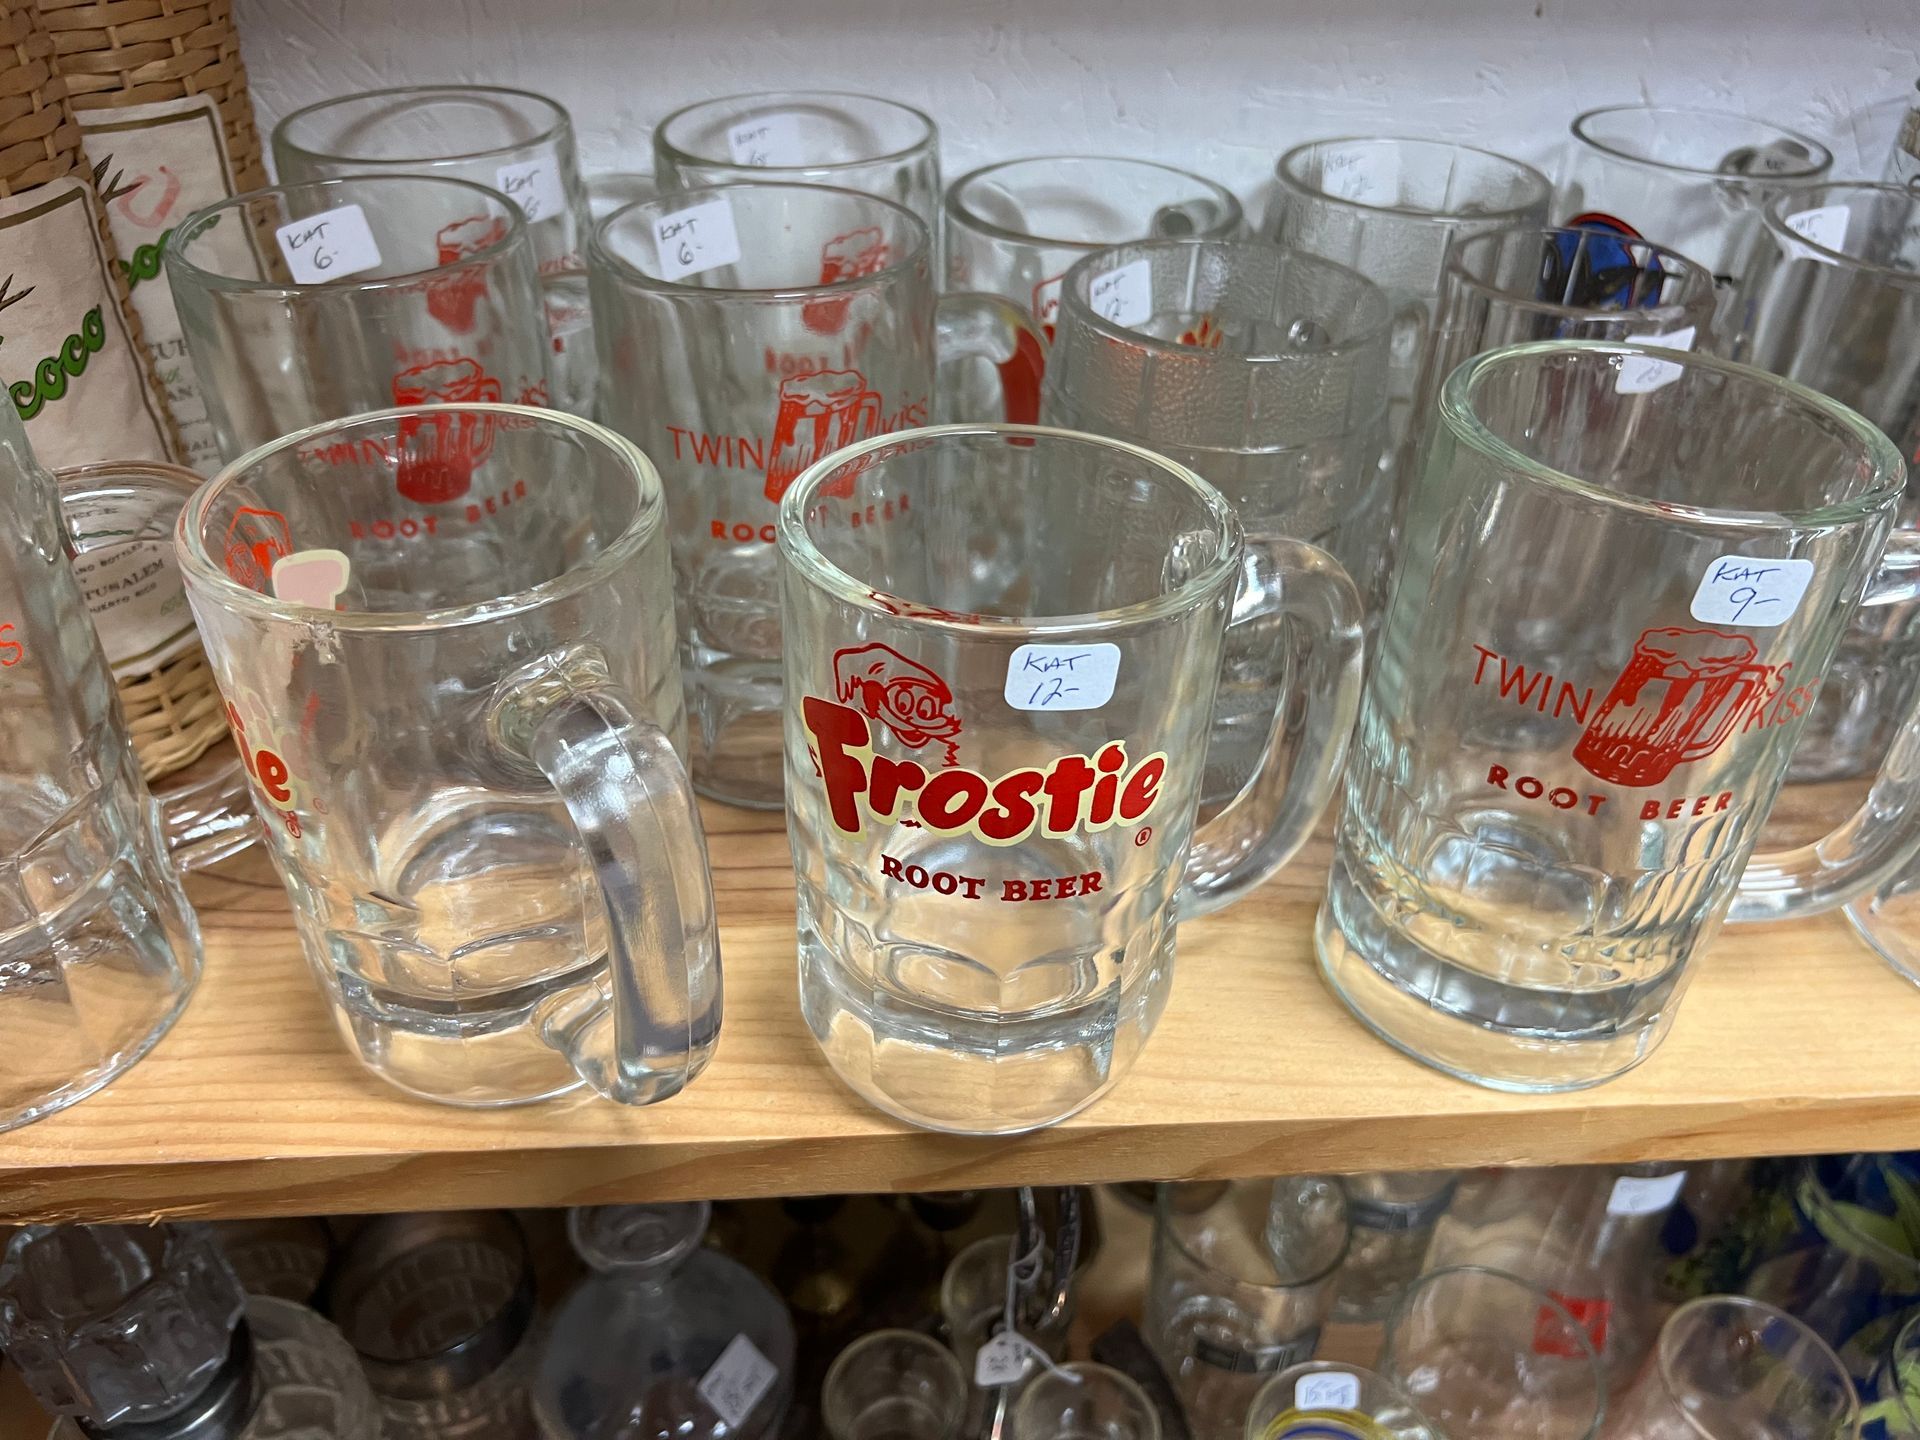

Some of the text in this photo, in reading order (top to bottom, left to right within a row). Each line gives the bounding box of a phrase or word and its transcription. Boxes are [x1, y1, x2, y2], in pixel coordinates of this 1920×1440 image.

[286, 222, 329, 250] KAT
[659, 218, 698, 241] KAT
[666, 425, 765, 470] TWIN
[85, 558, 165, 600] TUSALEM
[1712, 562, 1781, 583] KAT
[1023, 652, 1092, 673] KAT
[1472, 643, 1594, 725] TWIN
[802, 694, 1168, 846] Frostie
[1486, 763, 1733, 821] ROOT BEER
[880, 853, 1104, 902] ROOT BEER
